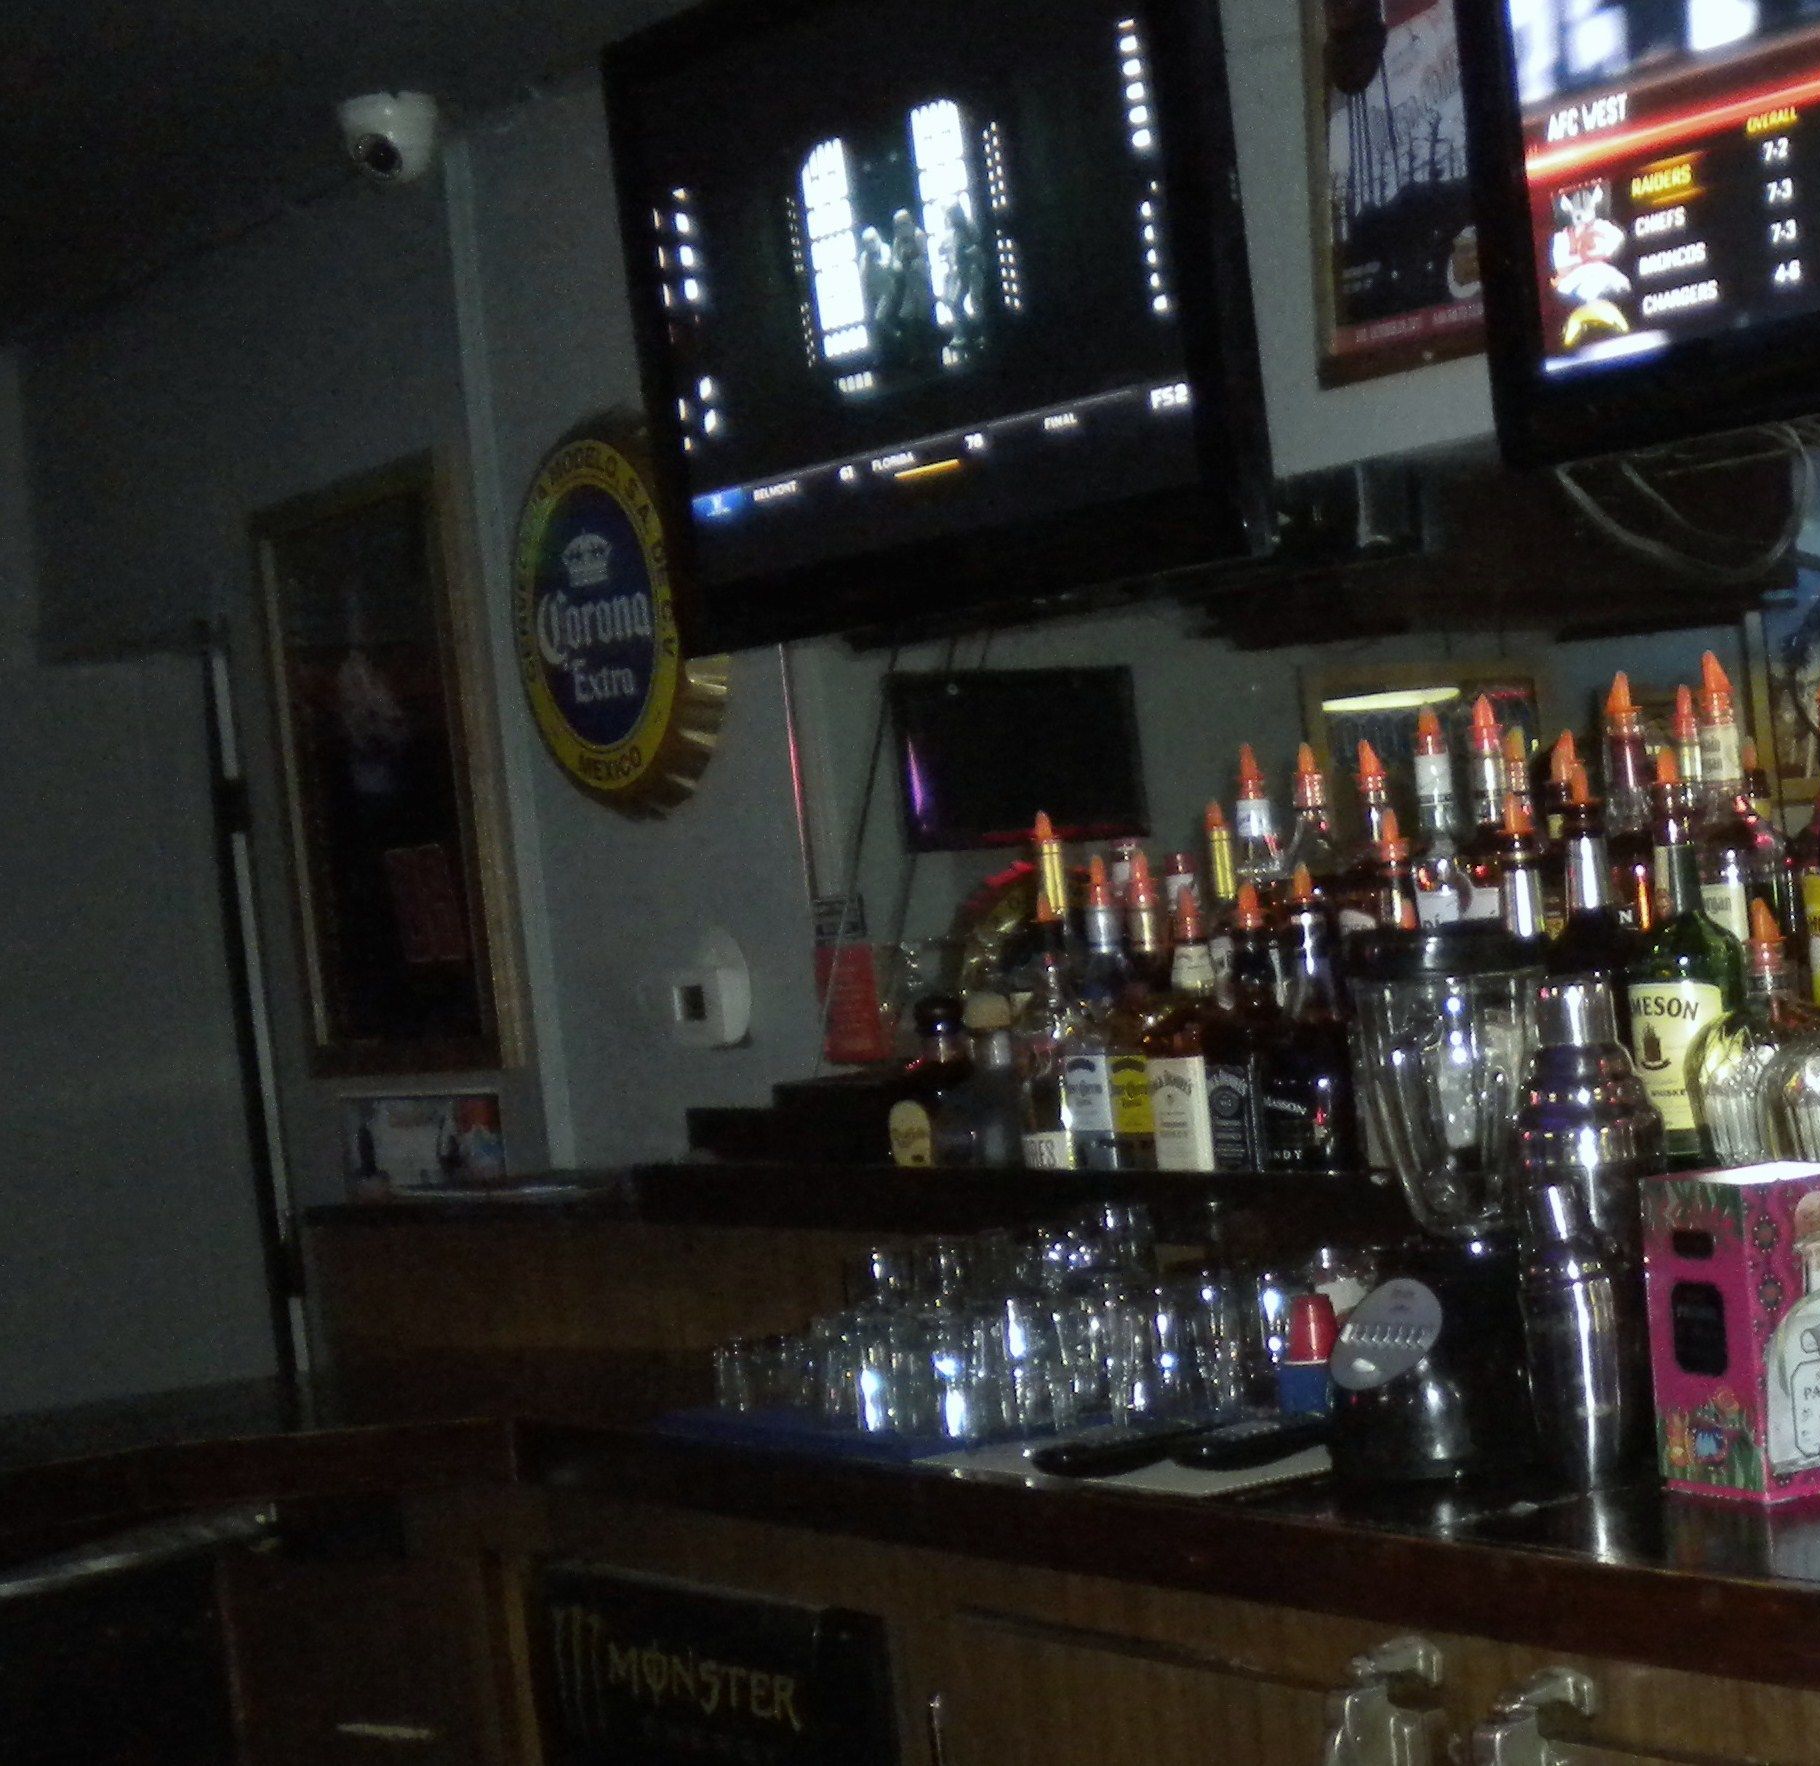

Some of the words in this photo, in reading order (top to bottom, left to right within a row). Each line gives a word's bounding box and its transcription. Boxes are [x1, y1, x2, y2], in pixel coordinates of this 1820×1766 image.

[1547, 106, 1579, 142] AFC
[1582, 91, 1628, 131] WEST
[1746, 106, 1798, 134] OVERALL
[1630, 163, 1693, 199] RAIDERS
[1762, 136, 1790, 162] 7-2
[1634, 205, 1686, 237] CHIEFS
[1766, 177, 1794, 204] 7-3
[1638, 241, 1707, 276] BRONCOS
[1770, 218, 1798, 243] 7-3
[1641, 279, 1719, 316] CHARGERS
[1149, 382, 1190, 410] FS2
[753, 480, 797, 502] BELMONT
[870, 452, 916, 473] FLORIDA
[1043, 412, 1079, 431] FINAL
[537, 588, 652, 666] Corona
[562, 655, 637, 702] Extra
[577, 744, 642, 782] MEXICO
[608, 1638, 802, 1733] MONSTER
